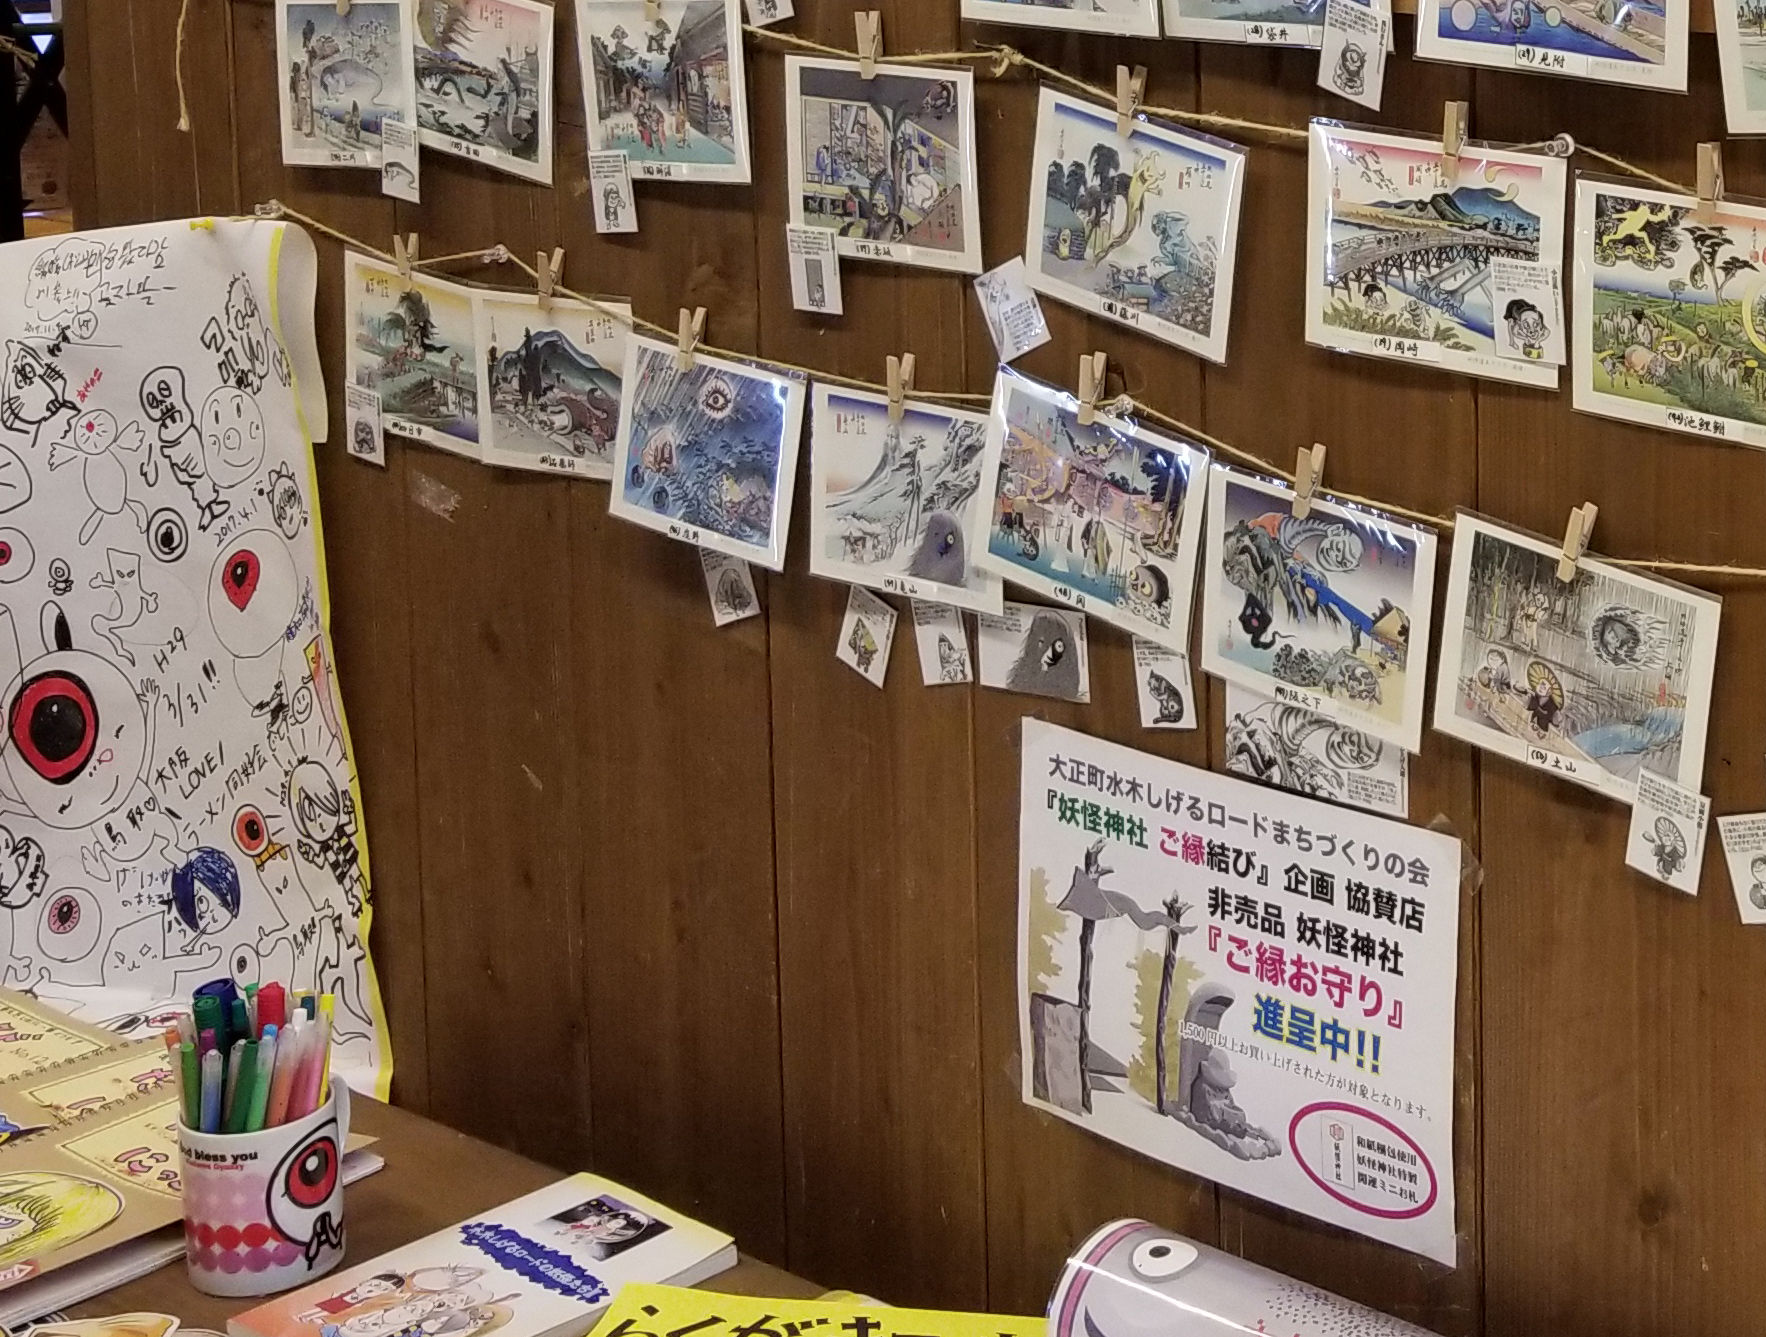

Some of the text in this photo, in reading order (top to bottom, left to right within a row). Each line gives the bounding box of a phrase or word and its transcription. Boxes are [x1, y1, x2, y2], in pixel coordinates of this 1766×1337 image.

[214, 499, 259, 546] 2017.4.1
[1047, 753, 1430, 887] 大正町水木しげるロードまちづくりの会
[1047, 790, 1425, 935] 『妖怪神社 ご縁結び』 企画 協賛店
[1207, 885, 1404, 977] 非売品 妖怪神社
[1207, 925, 1403, 1030] 『ご縁お守り』
[1252, 994, 1382, 1075] 進呈中!!
[194, 1149, 228, 1164] bless
[231, 1151, 258, 1165] you
